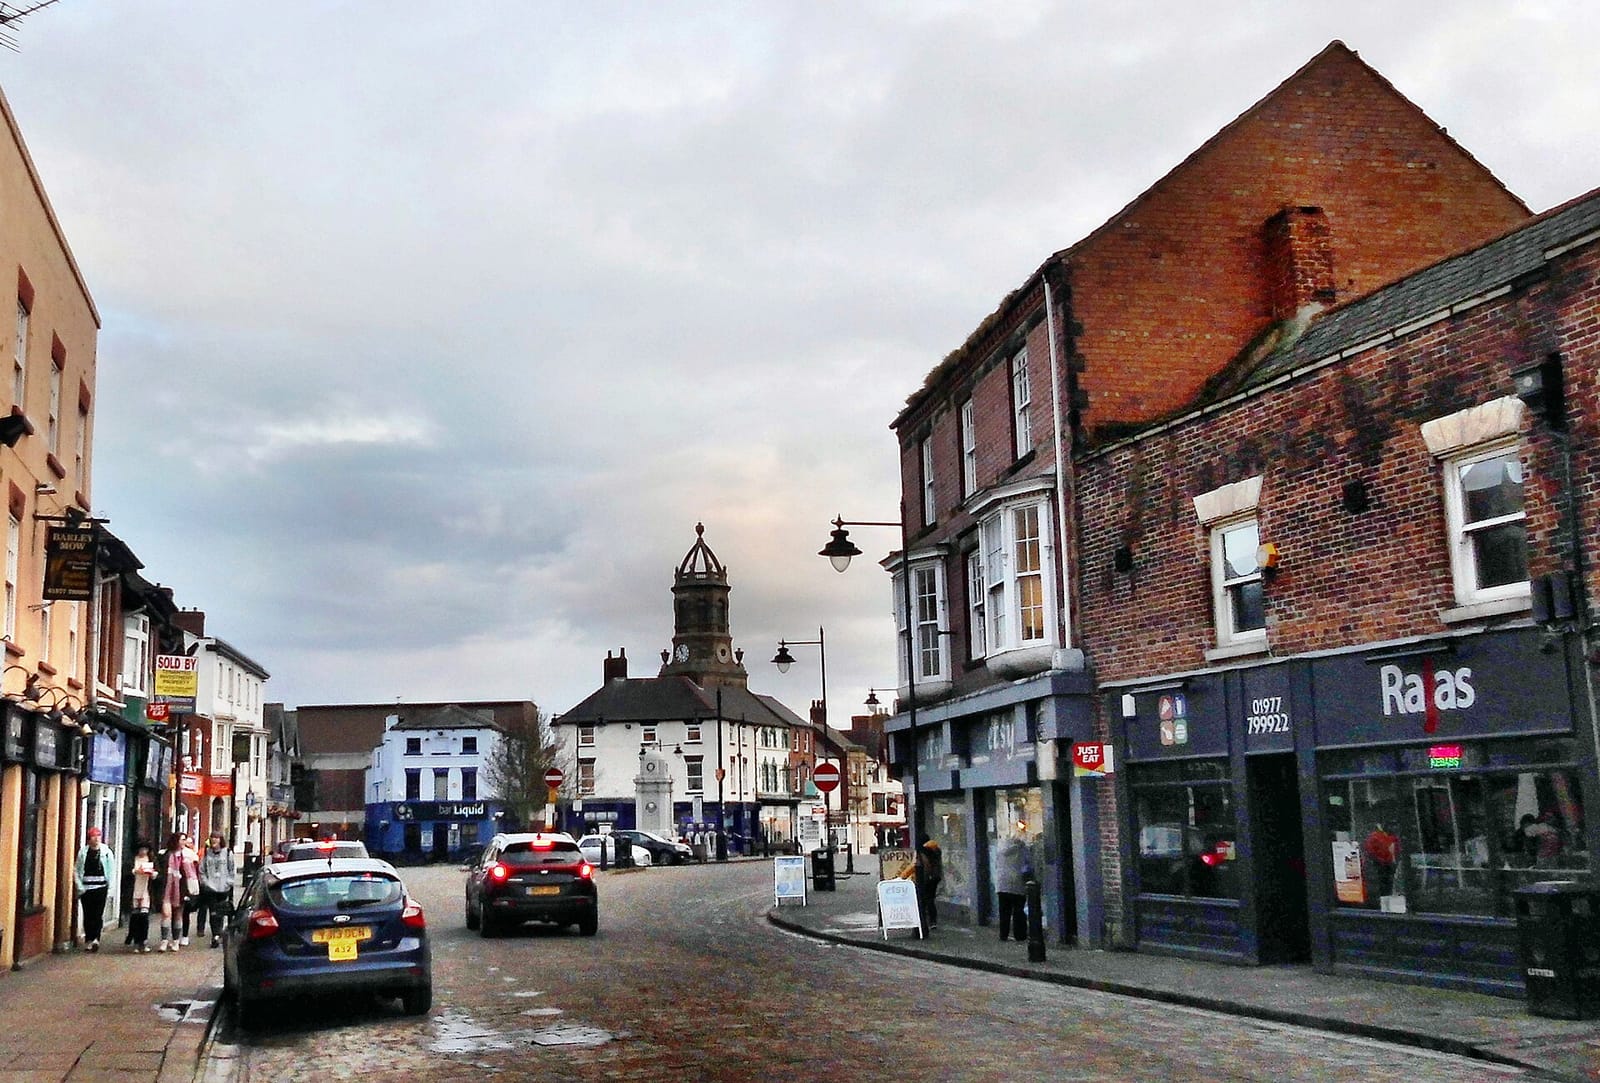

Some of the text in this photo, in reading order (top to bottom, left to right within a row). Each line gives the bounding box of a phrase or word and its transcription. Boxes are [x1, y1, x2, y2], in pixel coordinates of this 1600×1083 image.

[53, 533, 92, 542] BARLEY
[60, 542, 86, 550] MOW
[158, 656, 197, 670] SOLD BY
[1380, 656, 1475, 735] Rajas
[1252, 697, 1281, 715] 01977
[1247, 713, 1289, 734] 799922
[1077, 746, 1099, 756] JUST
[1082, 755, 1100, 763] EAT
[439, 803, 484, 818] bar Liquid
